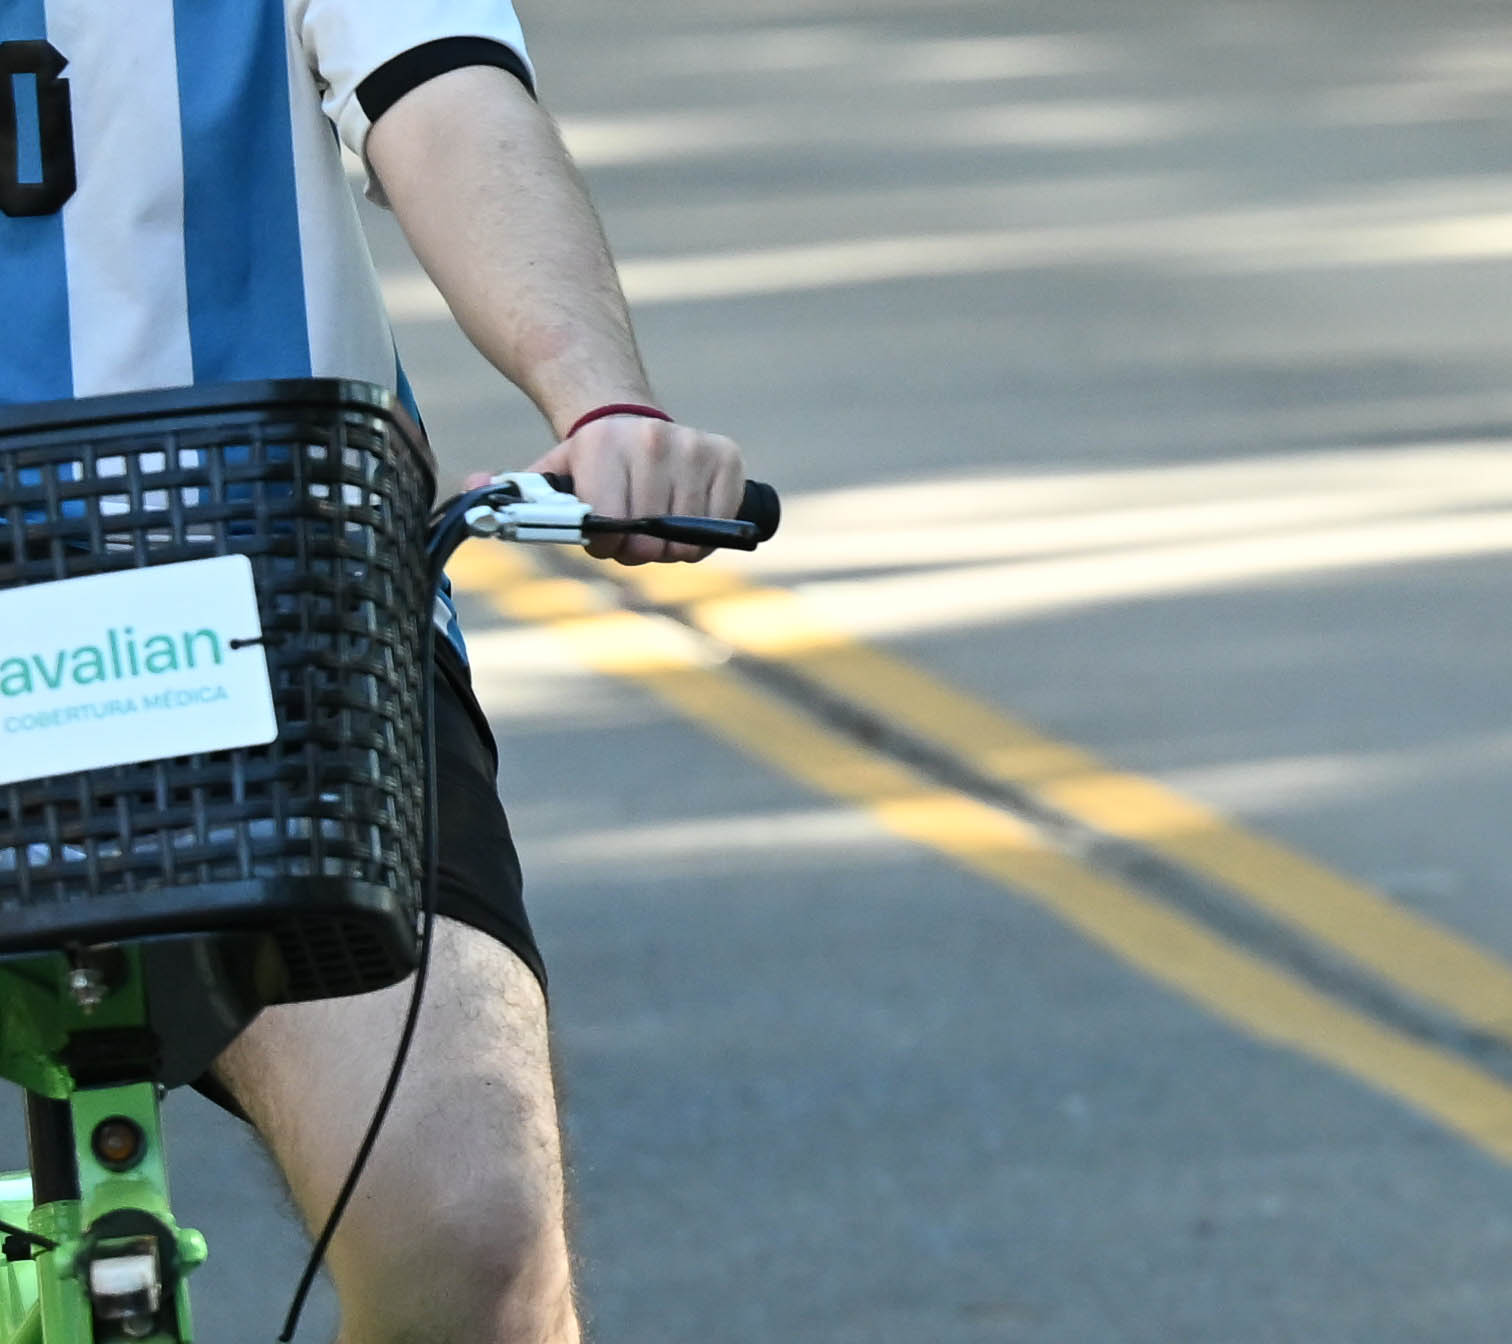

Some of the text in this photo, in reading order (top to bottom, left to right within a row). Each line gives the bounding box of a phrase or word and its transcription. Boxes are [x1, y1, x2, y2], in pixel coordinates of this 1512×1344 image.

[0, 625, 223, 698] avalian
[5, 683, 229, 735] COBERTURA MÉDICA
